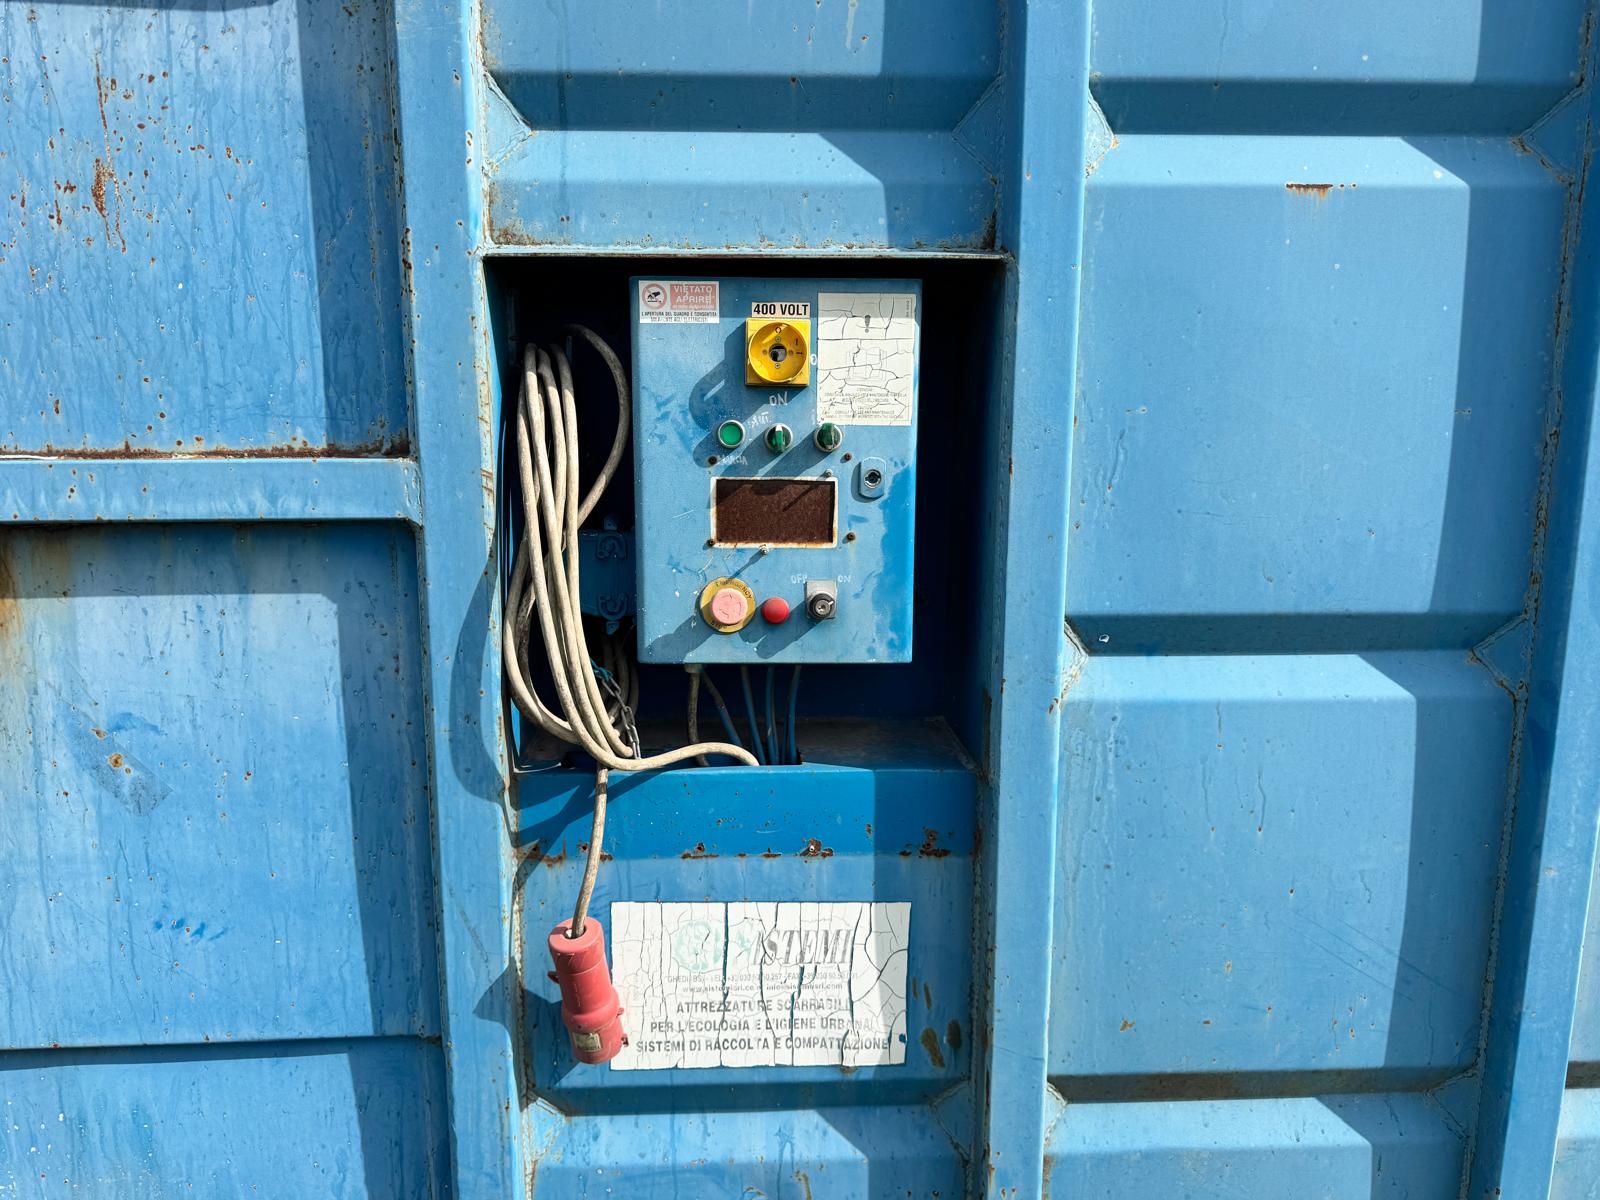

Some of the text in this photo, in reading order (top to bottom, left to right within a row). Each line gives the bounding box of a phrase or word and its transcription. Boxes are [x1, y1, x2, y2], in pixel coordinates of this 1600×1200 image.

[673, 285, 713, 293] VIETATO
[676, 295, 712, 303] APRIRE
[753, 303, 809, 316] 400 VOLT
[769, 391, 788, 406] ON
[837, 574, 852, 583] ON
[676, 999, 774, 1013] ATTREZZATURE
[650, 1021, 674, 1033] PER
[678, 1018, 750, 1033] L'ECOLOGIA
[755, 1018, 761, 1031] E
[765, 1017, 819, 1031] L'IGIENE
[636, 1037, 889, 1054] SISTEMI DI RACCOLTA E COMPATTAZIONE
